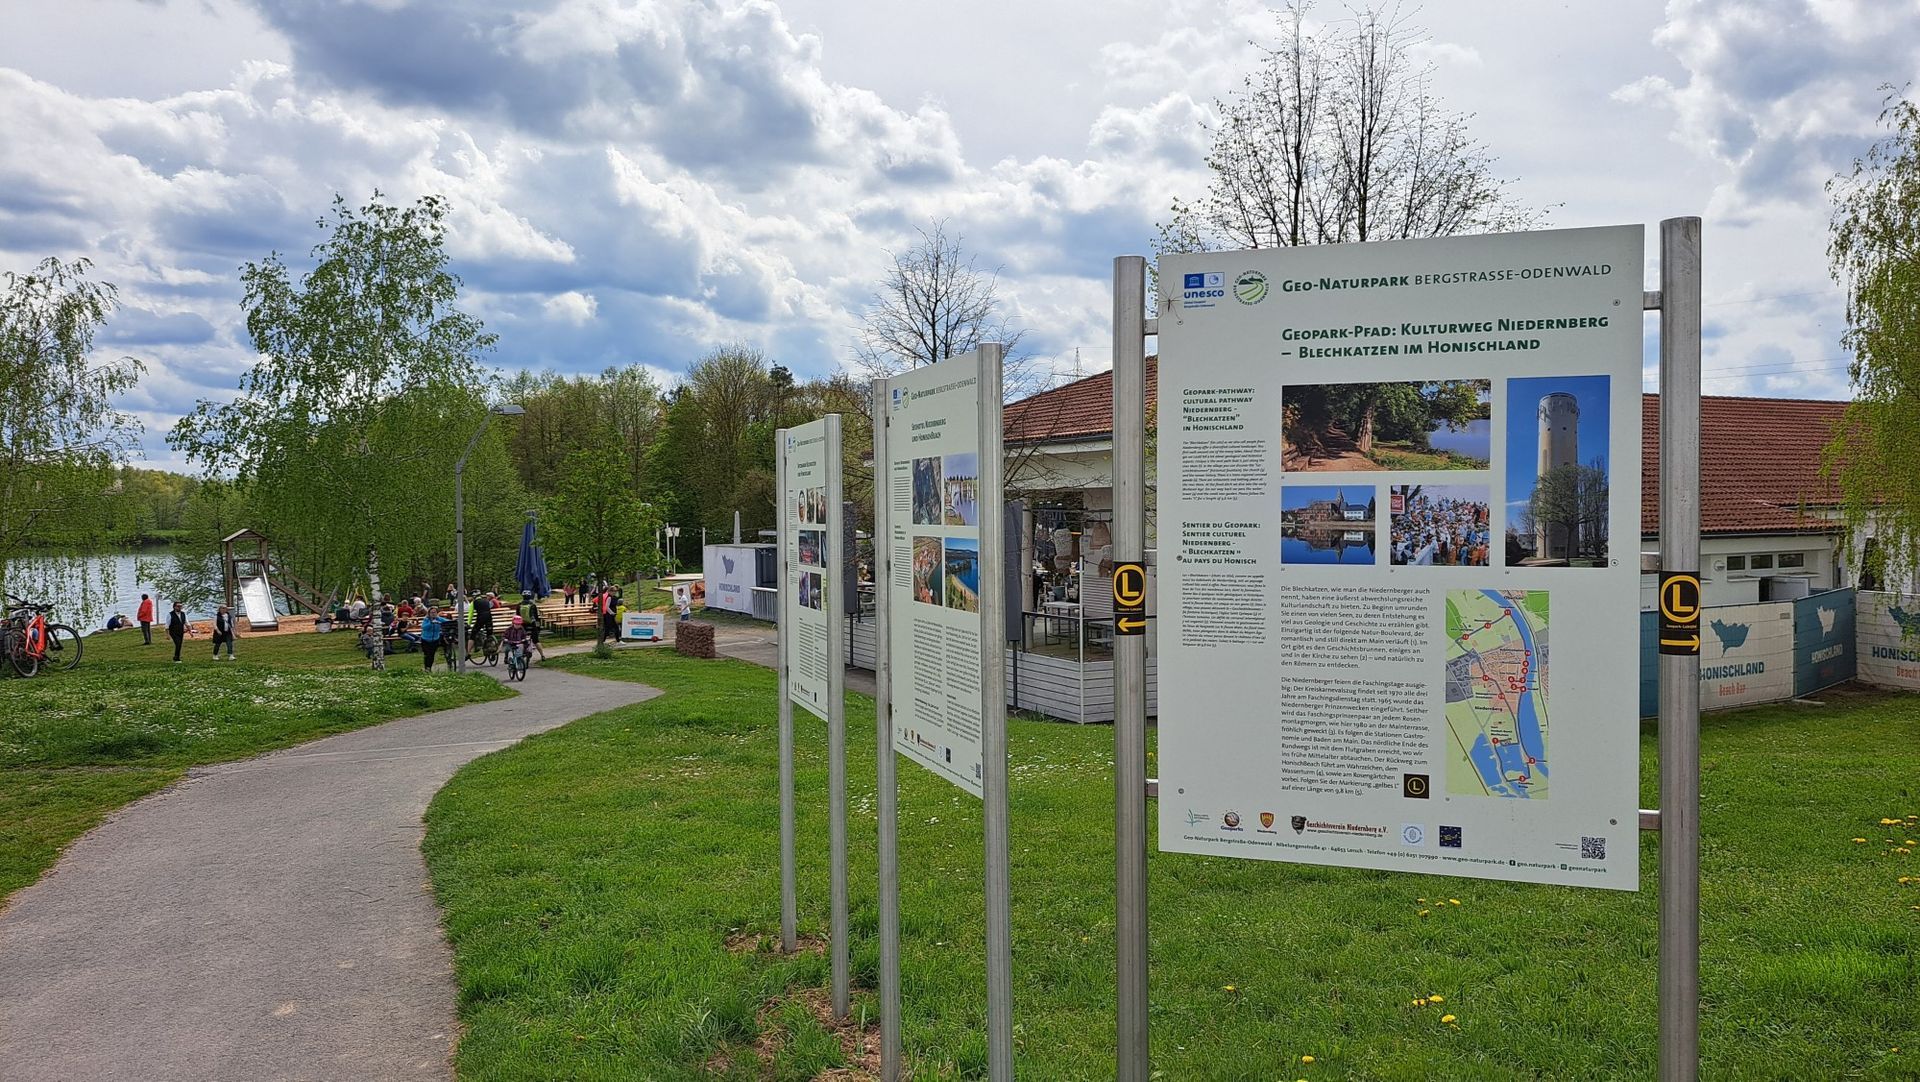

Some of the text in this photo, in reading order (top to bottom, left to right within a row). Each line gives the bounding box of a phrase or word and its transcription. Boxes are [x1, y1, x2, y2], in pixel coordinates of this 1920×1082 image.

[1282, 264, 1612, 292] GEO-NATURPARK BERGSTRASSE-ODENWALD
[1184, 290, 1224, 298] unesco
[1282, 317, 1609, 340] GEOPARK-PFAD: KULTURWEG NIEDERNBERG
[1299, 344, 1399, 358] BLECHKATZEN
[1404, 344, 1423, 354] IM
[1428, 339, 1540, 353] HONISCHLAND
[1122, 572, 1139, 597] L
[1672, 584, 1694, 612] L
[1382, 613, 1417, 621] Entstehung
[1292, 677, 1333, 685] Niedernberger
[1362, 680, 1404, 688] Faschingstage
[1719, 683, 1735, 696] Beach
[1281, 702, 1324, 710] Niedernberger
[1389, 724, 1429, 732] Mainterrasse,
[1386, 757, 1413, 766] Rückweg
[1338, 780, 1372, 788] Markierung
[1347, 824, 1377, 833] Niedernberg
[1442, 856, 1505, 865] www.geo-naturpark.de
[1568, 865, 1607, 873] geonaturpark
